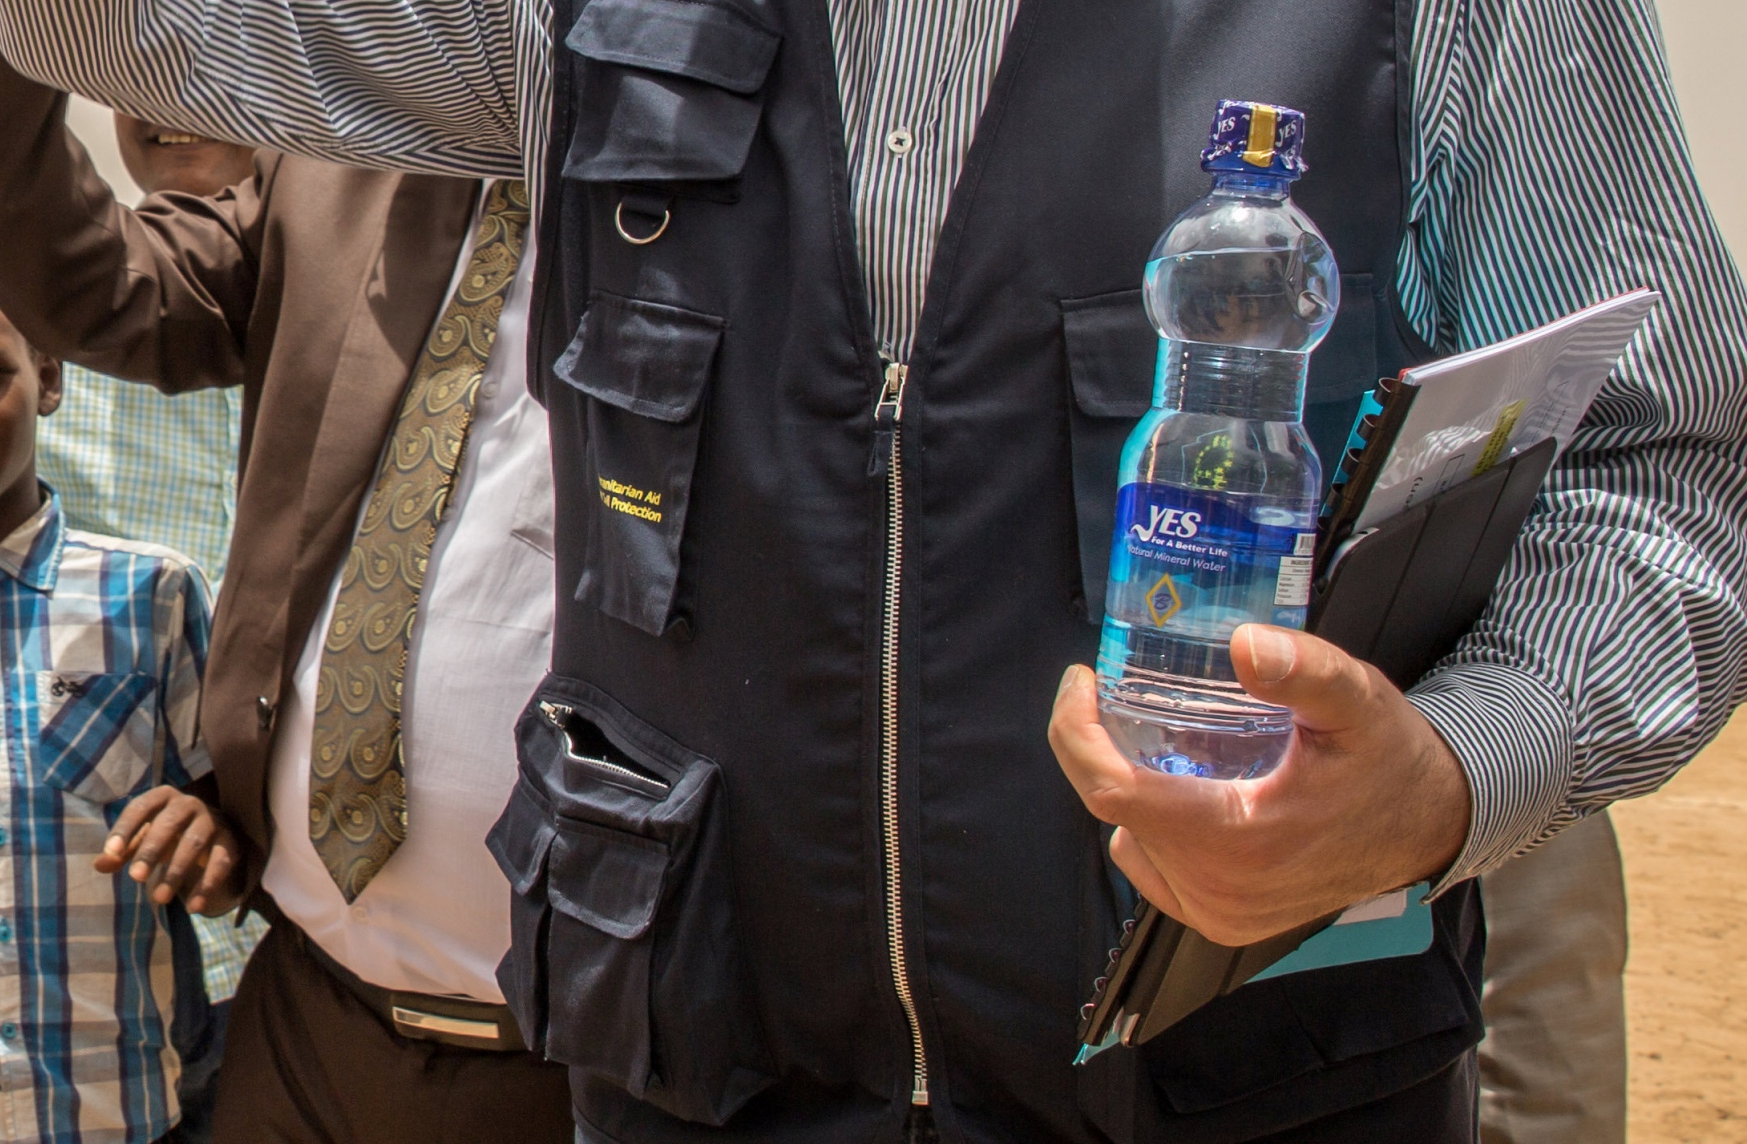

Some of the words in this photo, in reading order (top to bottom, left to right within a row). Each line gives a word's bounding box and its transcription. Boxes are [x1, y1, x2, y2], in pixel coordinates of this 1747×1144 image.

[1213, 116, 1236, 140] YES
[1275, 120, 1297, 146] YES
[598, 476, 644, 500] anitarian
[643, 490, 661, 506] Aid
[610, 496, 662, 523] Protection
[1130, 504, 1202, 542] YES
[1151, 536, 1166, 546] For
[1166, 539, 1174, 548] A
[1175, 540, 1207, 554] Better
[1209, 546, 1229, 558] Life
[1154, 548, 1191, 567] Mineral
[1192, 558, 1227, 573] Water
